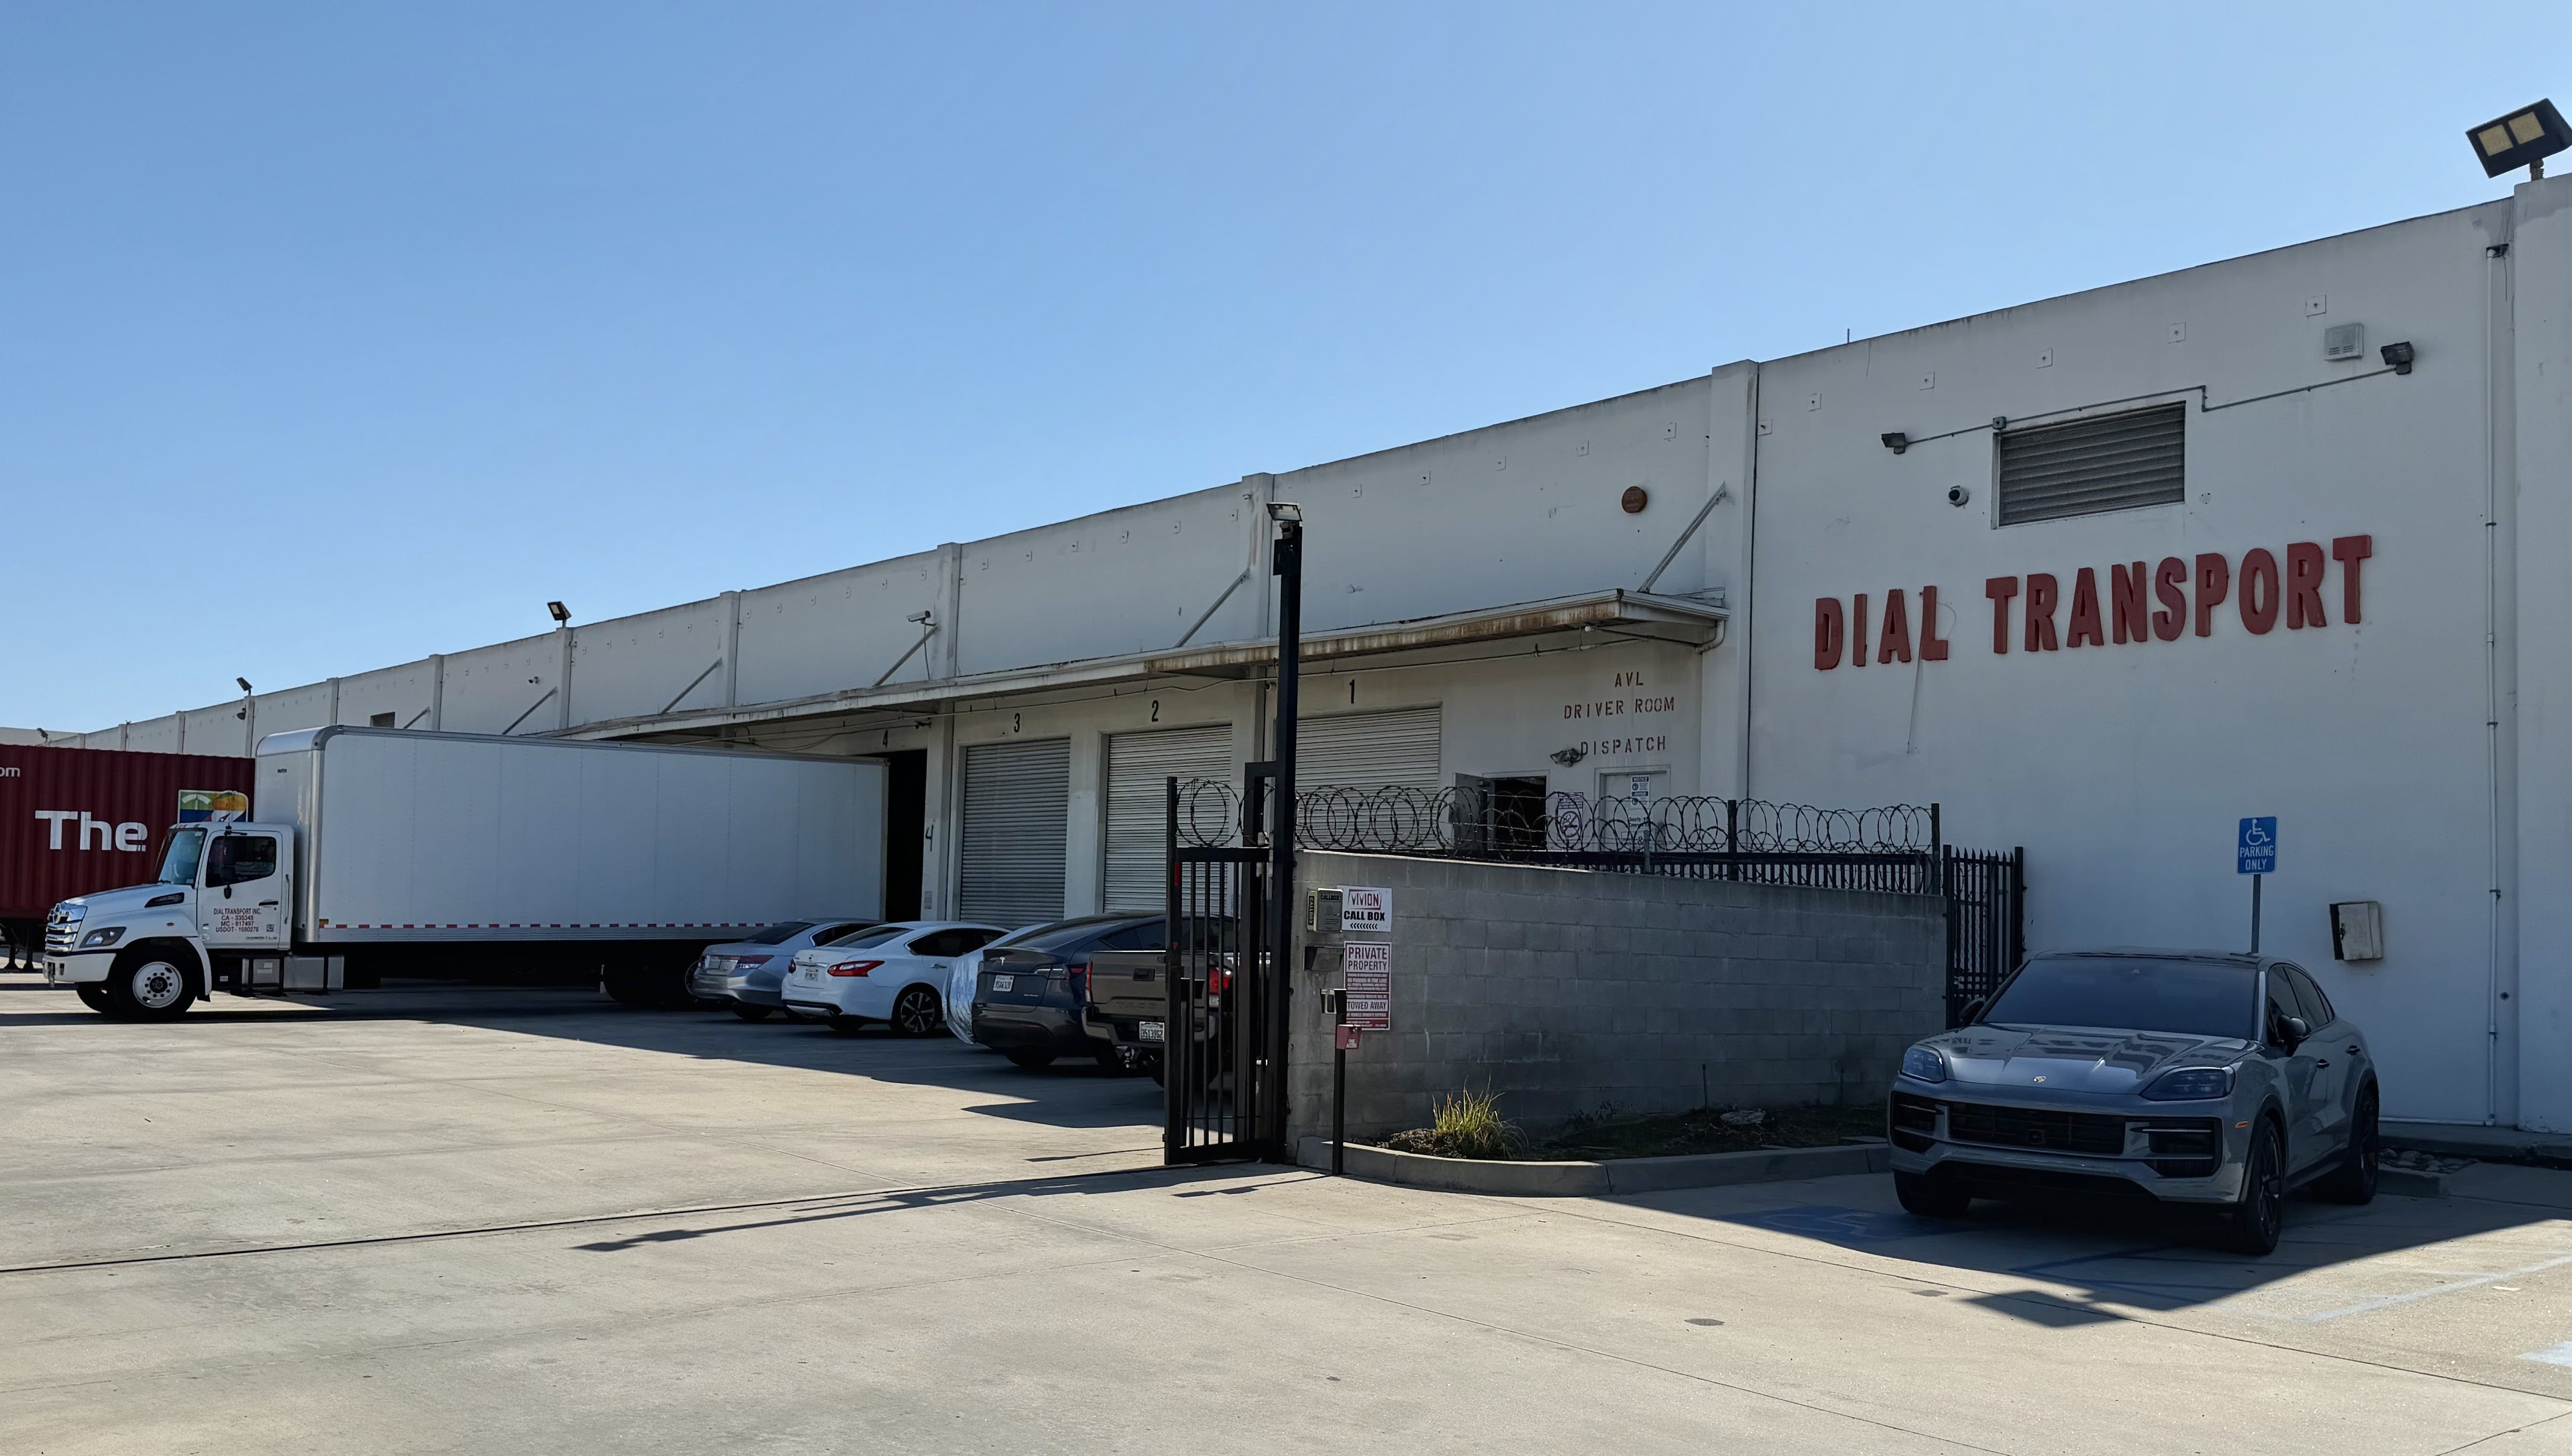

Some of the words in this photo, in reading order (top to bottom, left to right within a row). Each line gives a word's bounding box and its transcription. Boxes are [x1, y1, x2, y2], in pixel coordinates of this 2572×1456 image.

[1814, 586, 1948, 670] DIAL
[1986, 534, 2372, 654] TRANSPORT
[1615, 671, 1644, 688] AVL
[1349, 679, 1356, 704] 1
[1151, 699, 1158, 722] 2
[1564, 700, 1624, 720] DRIVER
[1635, 696, 1675, 713] ROOM
[1013, 712, 1021, 733] 3
[883, 729, 888, 747] 4
[1581, 735, 1666, 756] DISPATCH
[35, 810, 148, 852] The
[925, 824, 934, 852] 4
[2240, 845, 2274, 857] PARKING
[2245, 858, 2267, 871] ONLY
[1351, 893, 1380, 906] VIVION
[1344, 910, 1365, 920] CALL
[1367, 912, 1385, 921] BOX
[1348, 947, 1387, 960] PRIVATE
[1348, 960, 1387, 970] PROPERTY
[1347, 1001, 1368, 1009] TOWED
[1370, 1001, 1387, 1009] AWAY
